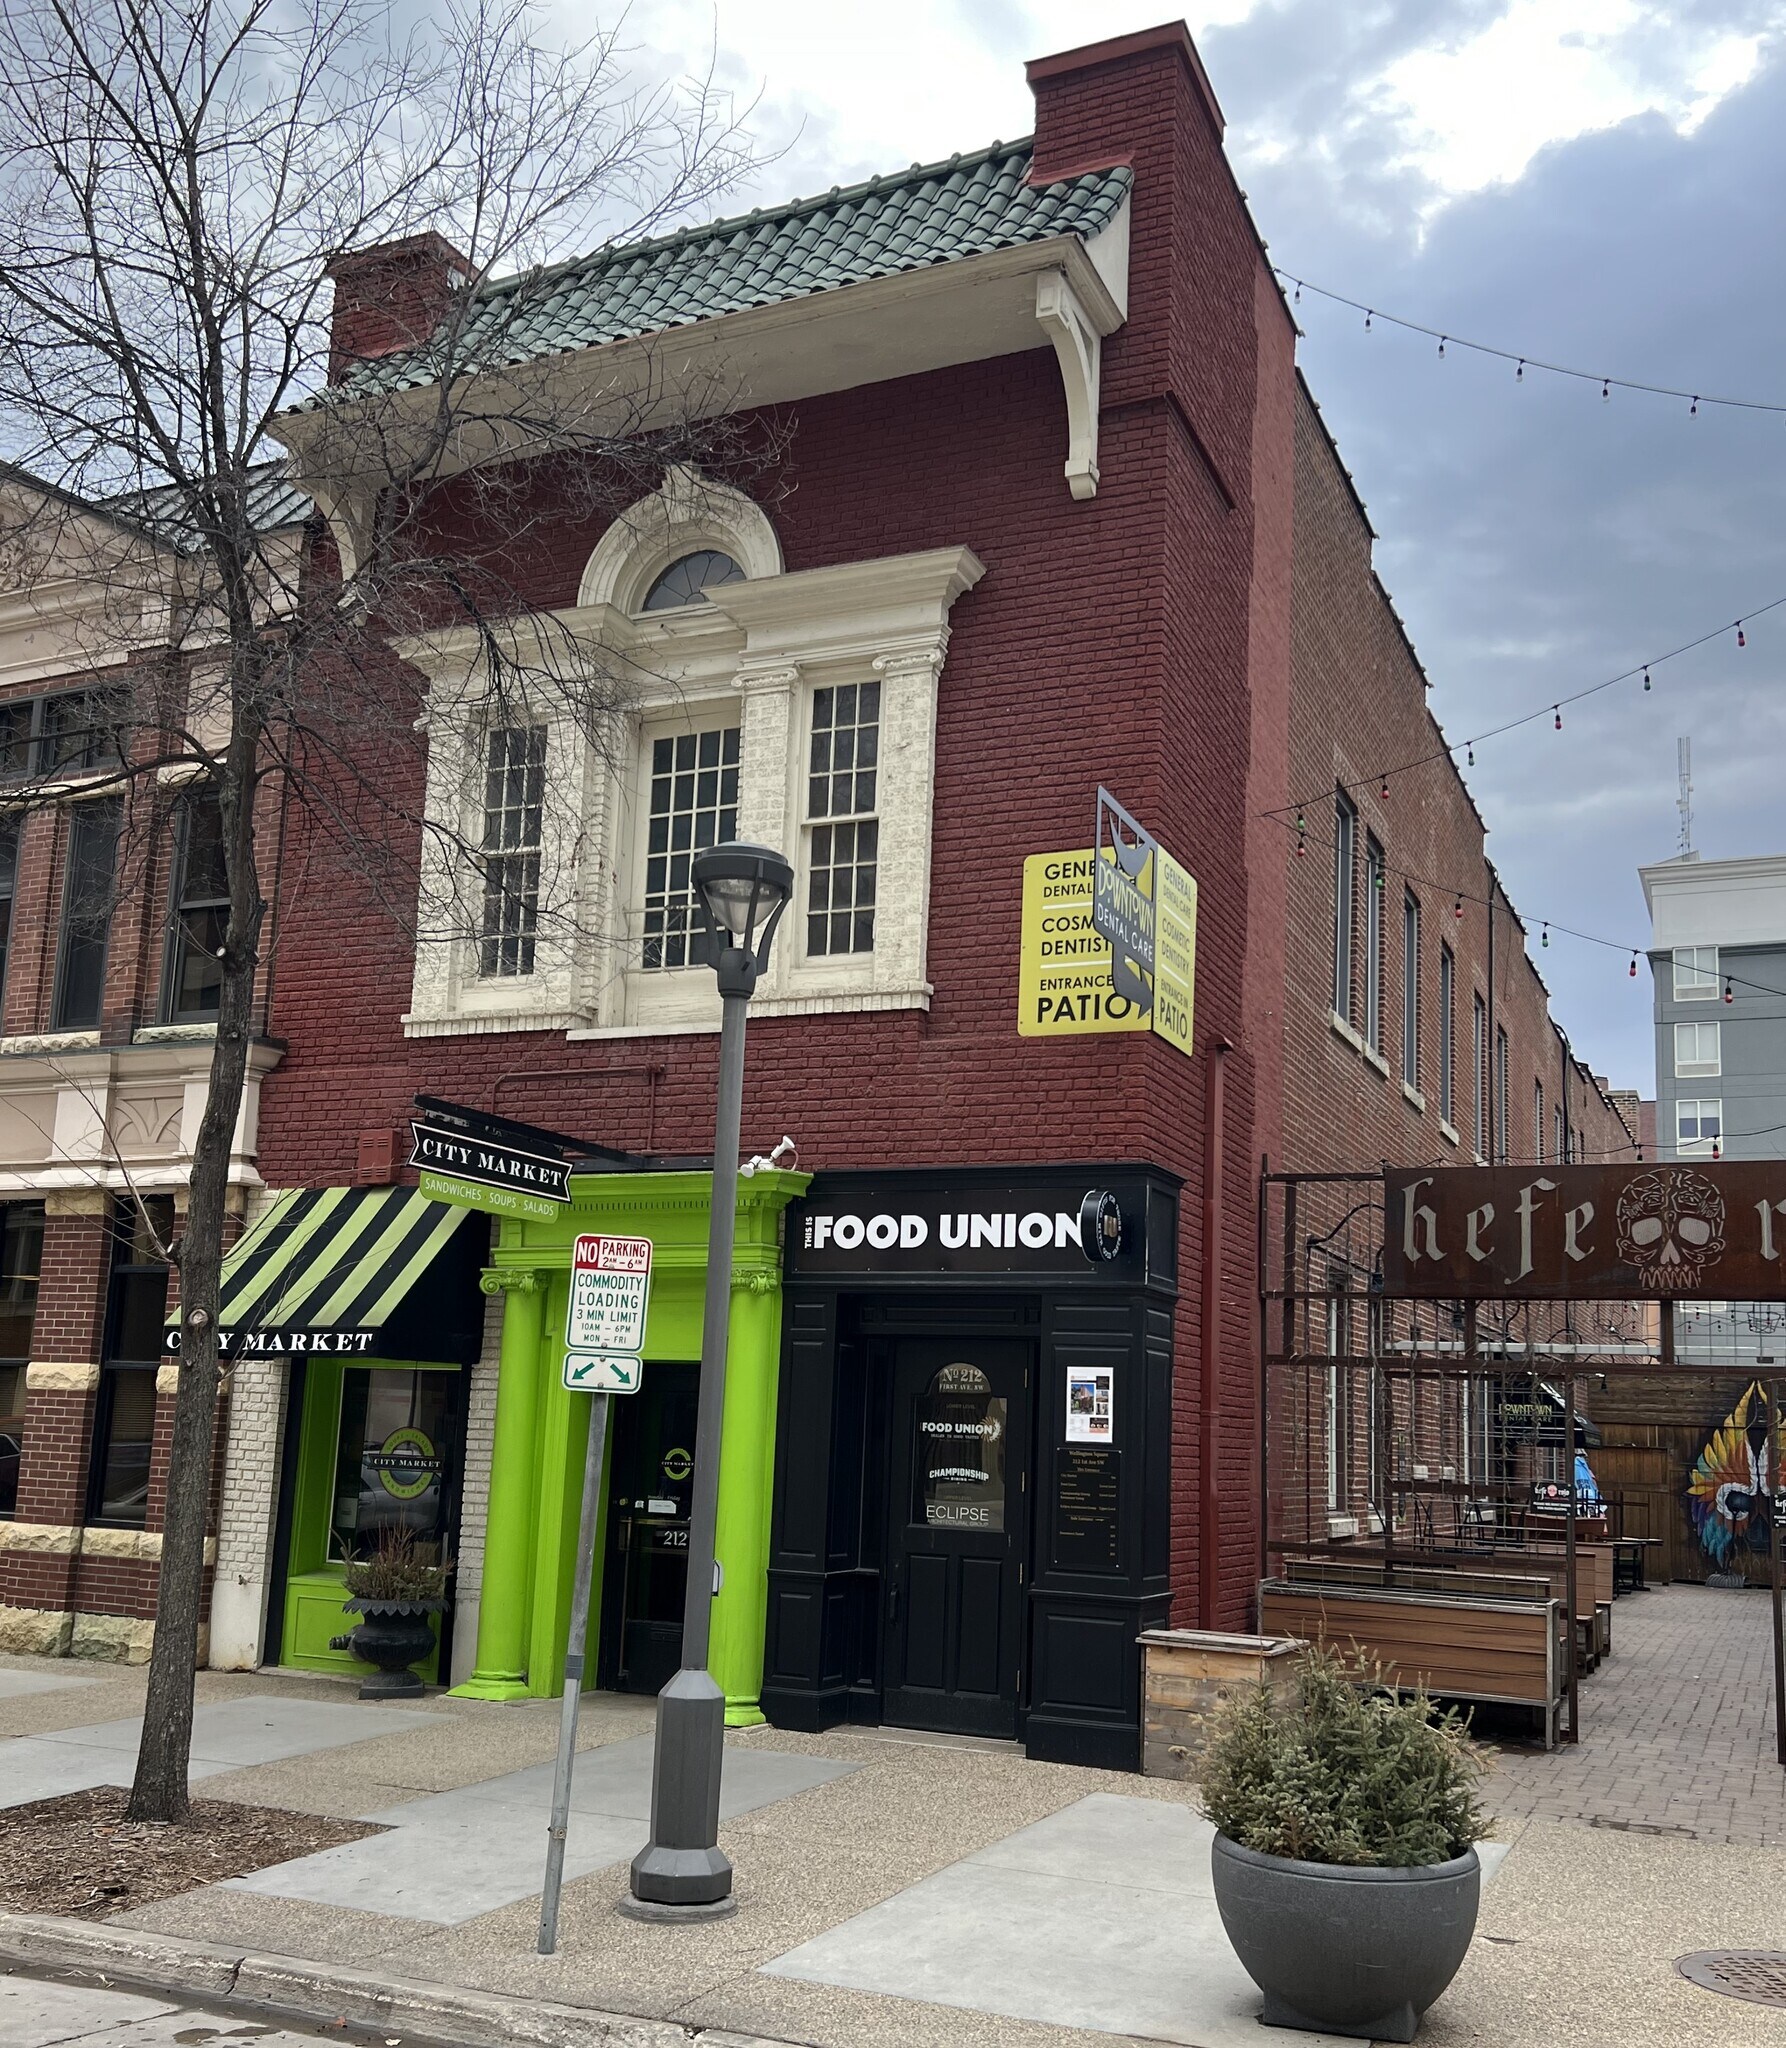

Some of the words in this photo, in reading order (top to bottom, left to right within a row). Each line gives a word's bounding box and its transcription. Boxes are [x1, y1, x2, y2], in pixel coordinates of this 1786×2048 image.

[1045, 860, 1095, 880] GENE
[1043, 883, 1093, 898] DENTAL
[1164, 863, 1191, 902] GENERAL
[1098, 861, 1153, 940] DOWNTOWN
[1163, 884, 1179, 908] DENTAL
[1180, 900, 1191, 919] CARE
[1042, 915, 1094, 933] COSM
[1097, 903, 1129, 943] DENTAL
[1131, 932, 1153, 963] CARE
[1162, 918, 1190, 953] COSMETIC
[1041, 937, 1110, 956] DENTIST
[1162, 940, 1189, 975] DENTISTRY
[1040, 975, 1114, 991] ENTRANCE
[1160, 978, 1183, 1006] ENTRANCE
[1037, 993, 1132, 1023] PATIO
[1160, 996, 1187, 1040] PATIO
[422, 1138, 472, 1165] CITY
[478, 1152, 562, 1187] MARKET
[425, 1178, 482, 1201] SANDWICHES
[489, 1192, 517, 1208] SOUPS
[523, 1200, 554, 1216] SALADS
[805, 1216, 813, 1226] IS
[804, 1226, 813, 1249] THIS
[813, 1214, 929, 1250] FOOD
[939, 1212, 1082, 1249] UNION
[1401, 1177, 1595, 1285] hefe
[577, 1242, 598, 1263] NO
[602, 1242, 646, 1258] PARKING
[578, 1274, 643, 1291] COMMODITY
[579, 1292, 639, 1309] LOADING
[576, 1309, 583, 1320] 3
[587, 1310, 604, 1321] MIN
[610, 1311, 638, 1323] LIMIT
[581, 1323, 600, 1331] 10AM
[615, 1325, 631, 1333] 6PM
[166, 1332, 235, 1350] CY
[244, 1333, 373, 1351] MARKET
[583, 1334, 600, 1342] MON
[613, 1336, 627, 1344] FRI
[960, 1368, 982, 1382] 212
[922, 1422, 953, 1433] FOOD
[954, 1423, 993, 1434] UNION
[373, 1458, 397, 1466] CITY
[399, 1459, 441, 1468] MARKET
[929, 1467, 989, 1481] CHAMPIONSHIP
[926, 1505, 989, 1522] ECLIPSE
[663, 1530, 688, 1546] 212
